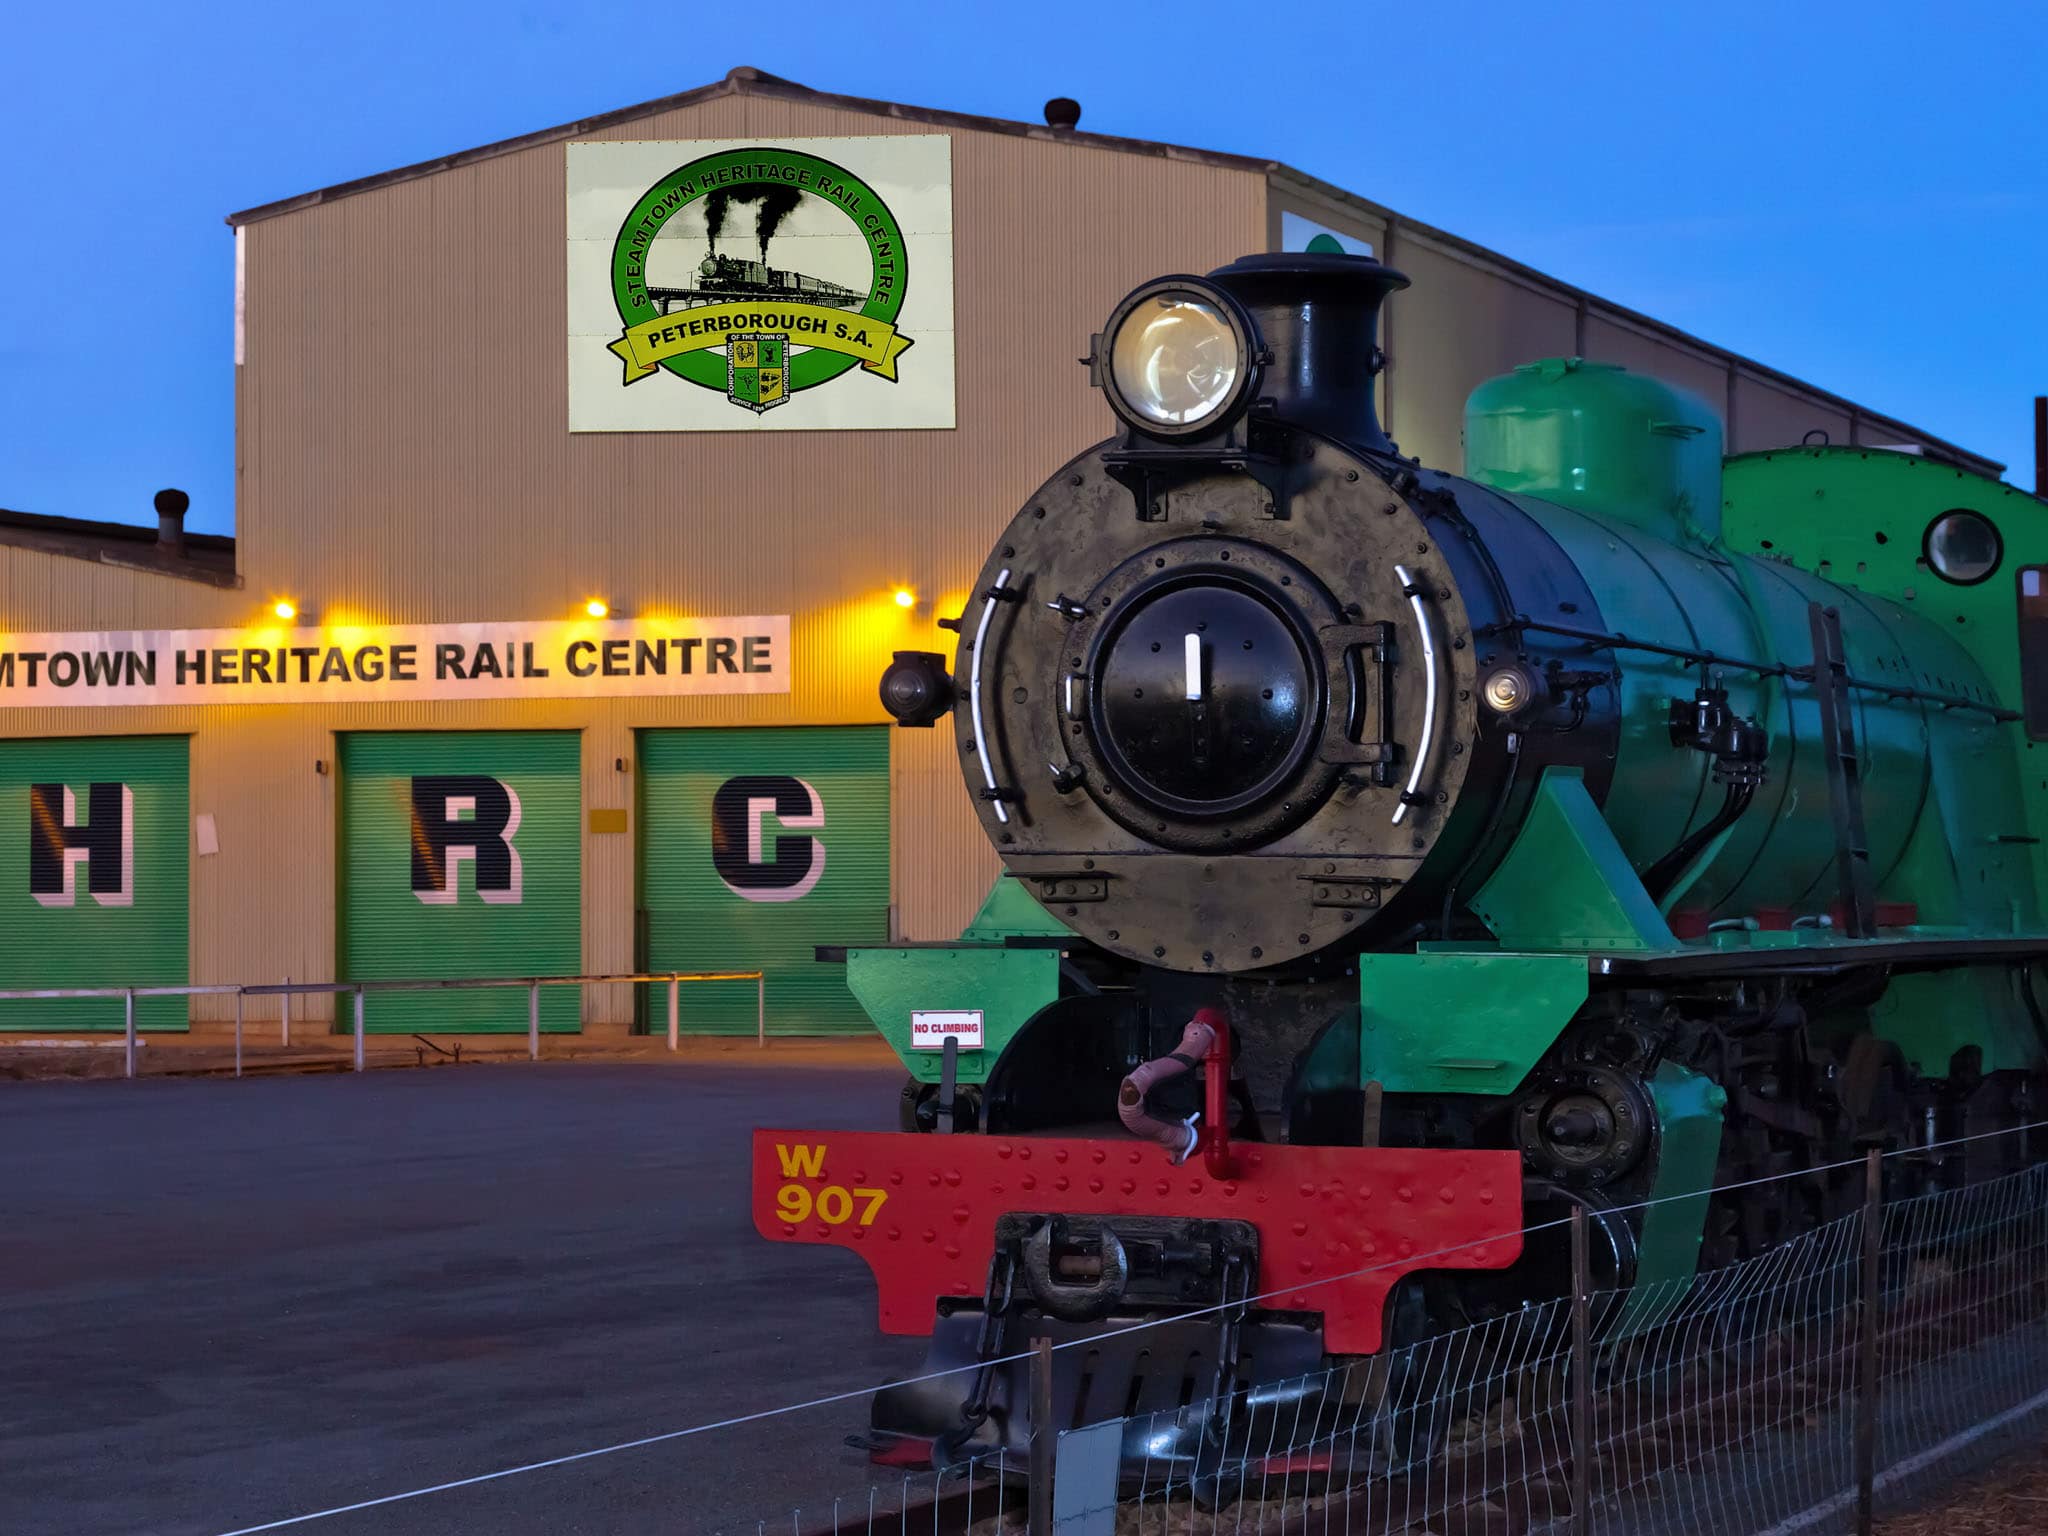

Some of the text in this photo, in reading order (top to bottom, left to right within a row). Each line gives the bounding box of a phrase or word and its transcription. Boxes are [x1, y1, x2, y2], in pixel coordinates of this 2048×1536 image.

[626, 164, 895, 308] STEAMTOWN HERITAGE RAIL CENTRE
[647, 313, 874, 349] PETERBOROUGH S.A.
[175, 645, 417, 686] HERITAGE
[435, 642, 549, 680] RAIL
[565, 636, 772, 678] CENTRE
[30, 783, 133, 907] H
[411, 775, 523, 904] R
[712, 776, 825, 902] C
[914, 1023, 979, 1033] NO CLIMBING
[775, 1144, 827, 1178] W
[775, 1184, 889, 1227] 907
